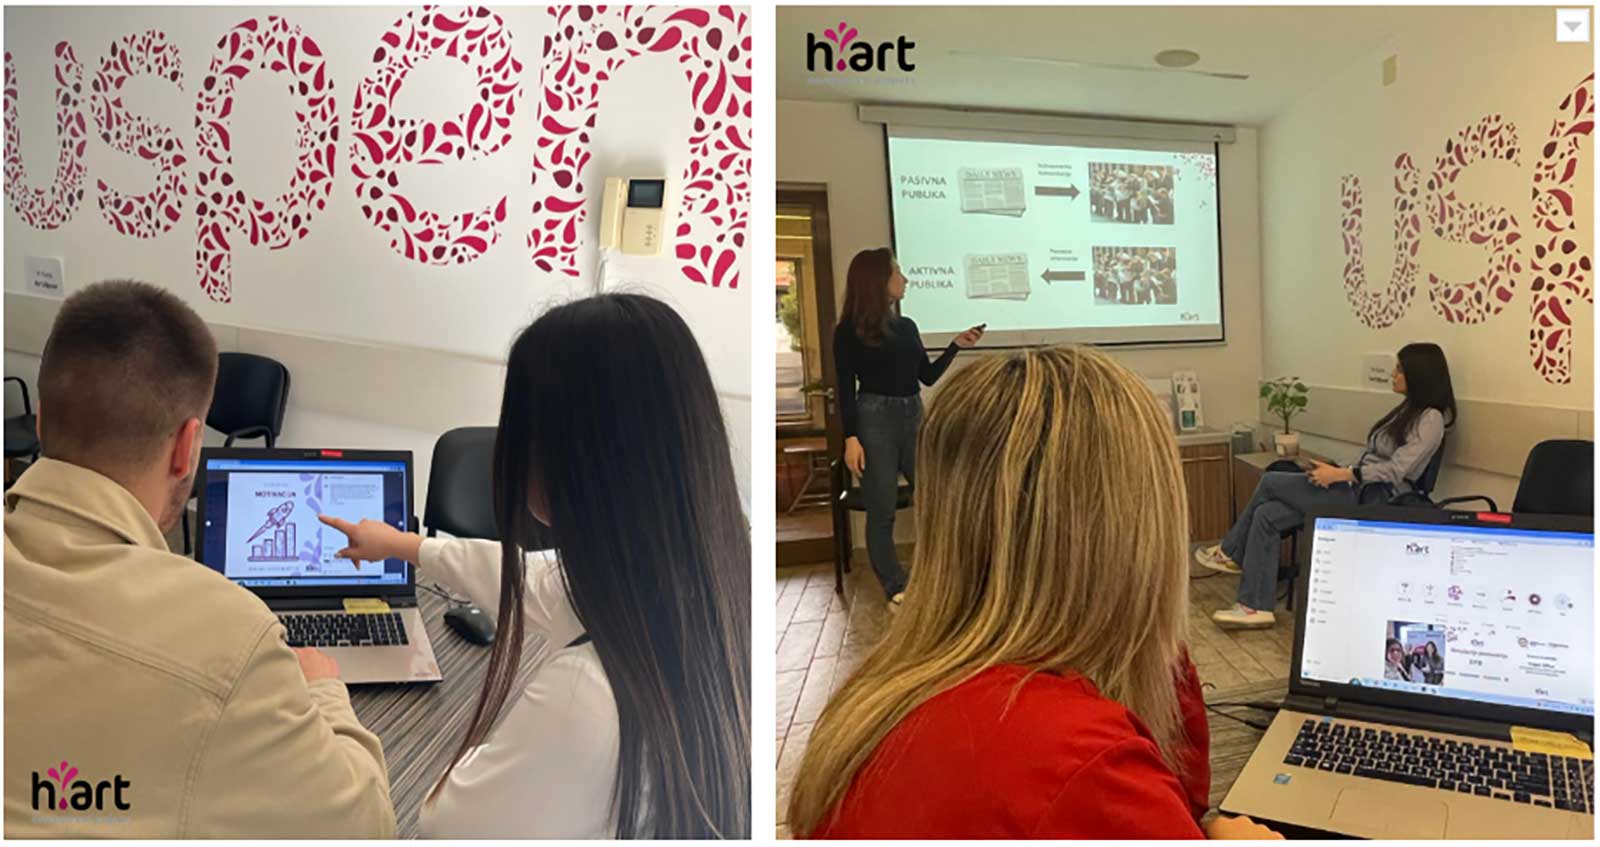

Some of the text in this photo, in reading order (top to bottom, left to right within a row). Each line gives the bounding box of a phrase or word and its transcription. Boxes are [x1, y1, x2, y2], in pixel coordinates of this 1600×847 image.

[900, 175, 947, 185] PASIVNA
[901, 189, 947, 199] PUBLIKA
[908, 266, 955, 275] AKTIVNA
[910, 280, 954, 289] PUBLIKA
